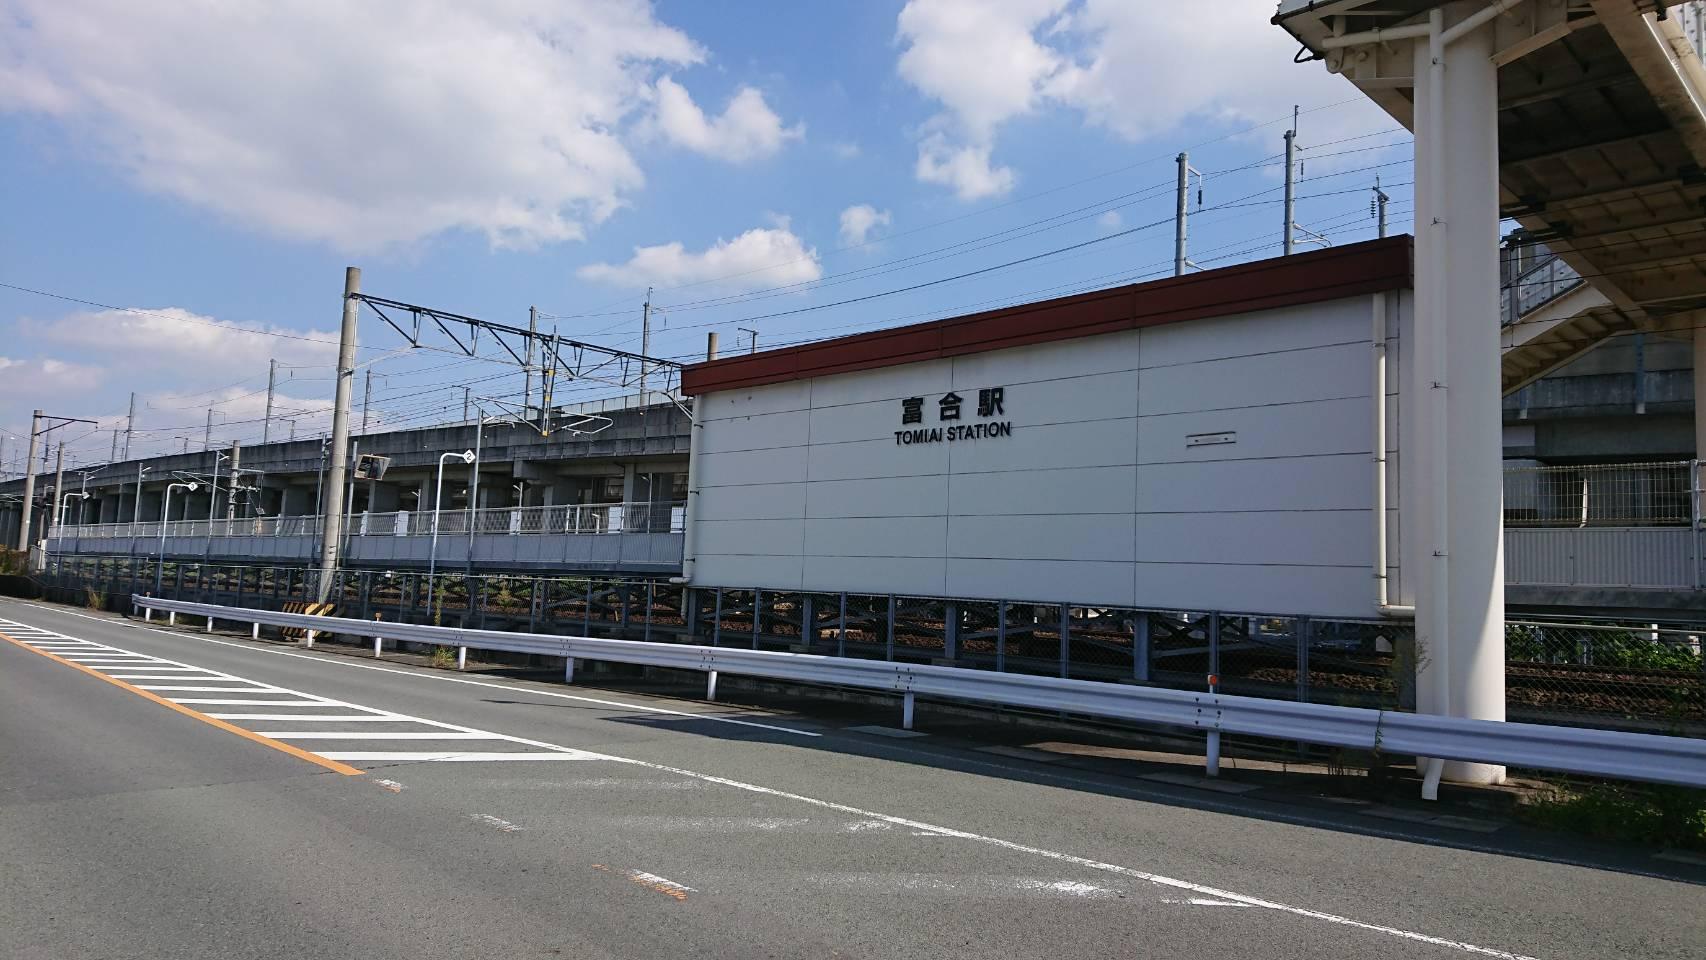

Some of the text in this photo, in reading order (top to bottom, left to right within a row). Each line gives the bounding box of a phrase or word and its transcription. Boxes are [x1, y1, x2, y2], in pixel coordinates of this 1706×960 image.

[902, 387, 1004, 425] 富合駅
[894, 421, 1011, 445] TOMIAI STATION
